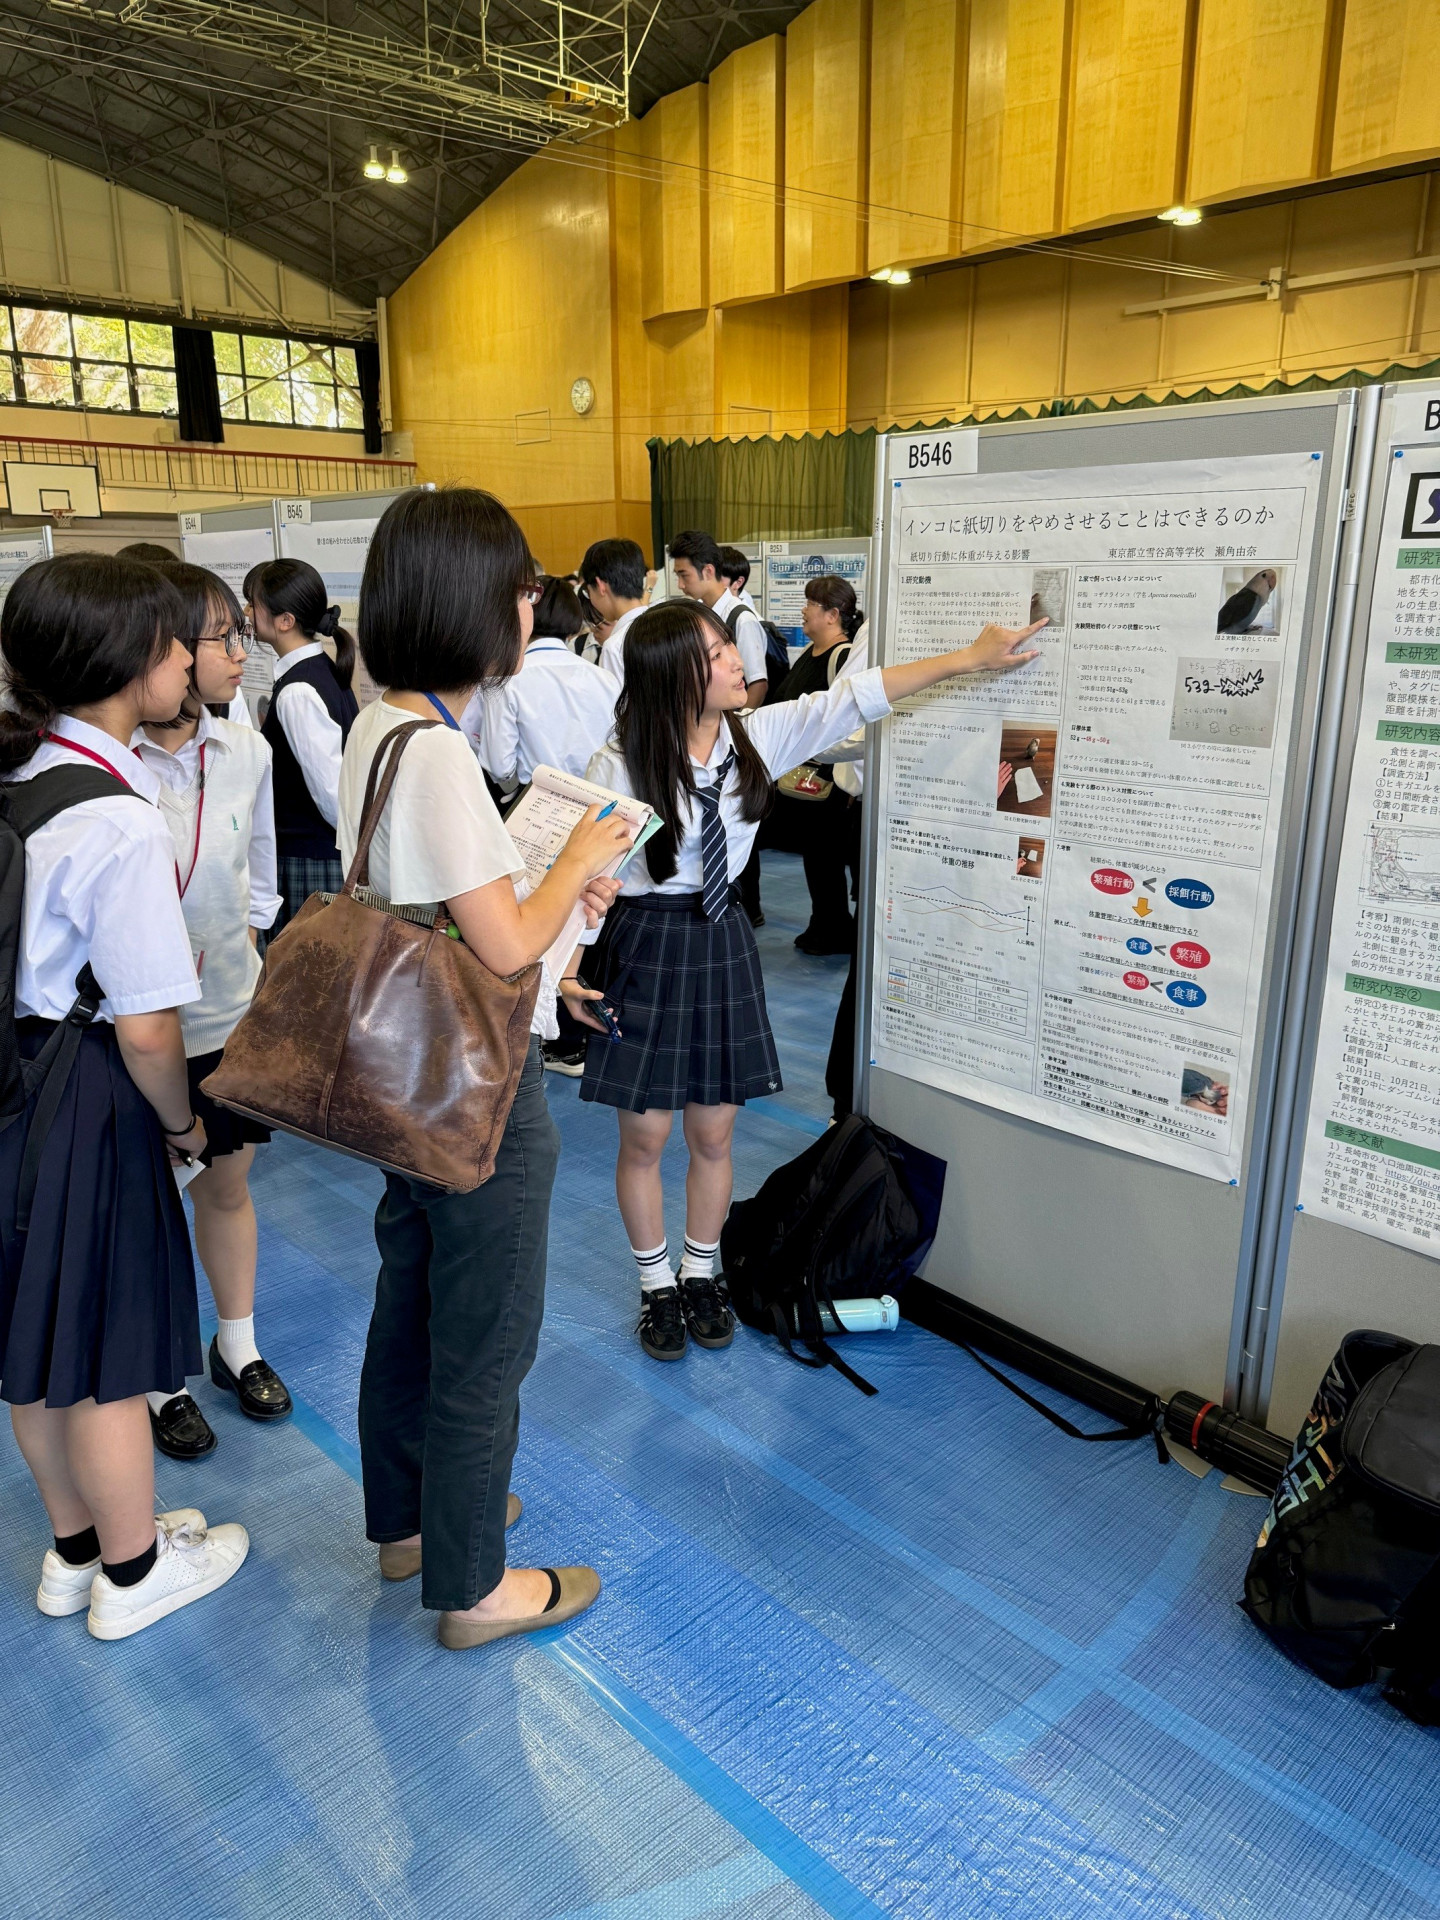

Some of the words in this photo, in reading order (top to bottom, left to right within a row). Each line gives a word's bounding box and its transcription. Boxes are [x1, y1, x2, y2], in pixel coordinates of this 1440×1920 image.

[908, 441, 952, 469] B546
[287, 504, 303, 519] B545
[905, 505, 1274, 537] インコに紙切りをやめさせることはできるのか
[909, 547, 1030, 564] 紙切り行動に体重が与える影響
[1107, 544, 1205, 560] 東京都立雪谷高等学校
[801, 561, 834, 572] Focus
[835, 560, 864, 572] Shift
[900, 575, 932, 585] 1.研究動機
[1410, 574, 1440, 586] 都市化
[1397, 587, 1439, 598] 地を失っ
[1395, 600, 1440, 611] ルの生息
[1394, 612, 1440, 624] を調査す
[1393, 646, 1438, 661] 本研究
[1388, 681, 1440, 692] や、タグに
[1386, 692, 1440, 705] 腹部模様を
[1385, 704, 1440, 718] 距離を計測
[1390, 746, 1440, 759] 食性を調べ
[1382, 767, 1429, 781] 【調査方法】
[1372, 798, 1440, 815] ③糞の鑑定を目
[1376, 810, 1403, 822] 【結果】
[940, 855, 975, 870] 体重の推移
[1093, 872, 1134, 890] 繁殖行動
[1167, 885, 1212, 904] 採餌行動
[1128, 938, 1148, 953] 食事
[1175, 946, 1203, 965] 繁殖
[1125, 974, 1146, 988] 繁殖
[1171, 984, 1199, 1003] 食事
[1352, 976, 1422, 1002] 研究内容②
[1345, 1034, 1388, 1052] 【調査方法】
[1342, 1053, 1368, 1067] 【結果】
[1338, 1082, 1364, 1096] 【考察】
[1341, 1092, 1440, 1127] 飼育個体がダンゴムシを
[1331, 1109, 1403, 1137] れたと考えられた。
[1332, 1101, 1440, 1136] ゴムシが糞の中から見つか
[1332, 1125, 1384, 1150] 参考文献
[1327, 1151, 1377, 1173] ガエルの食性
[1324, 1169, 1342, 1180] 佐野
